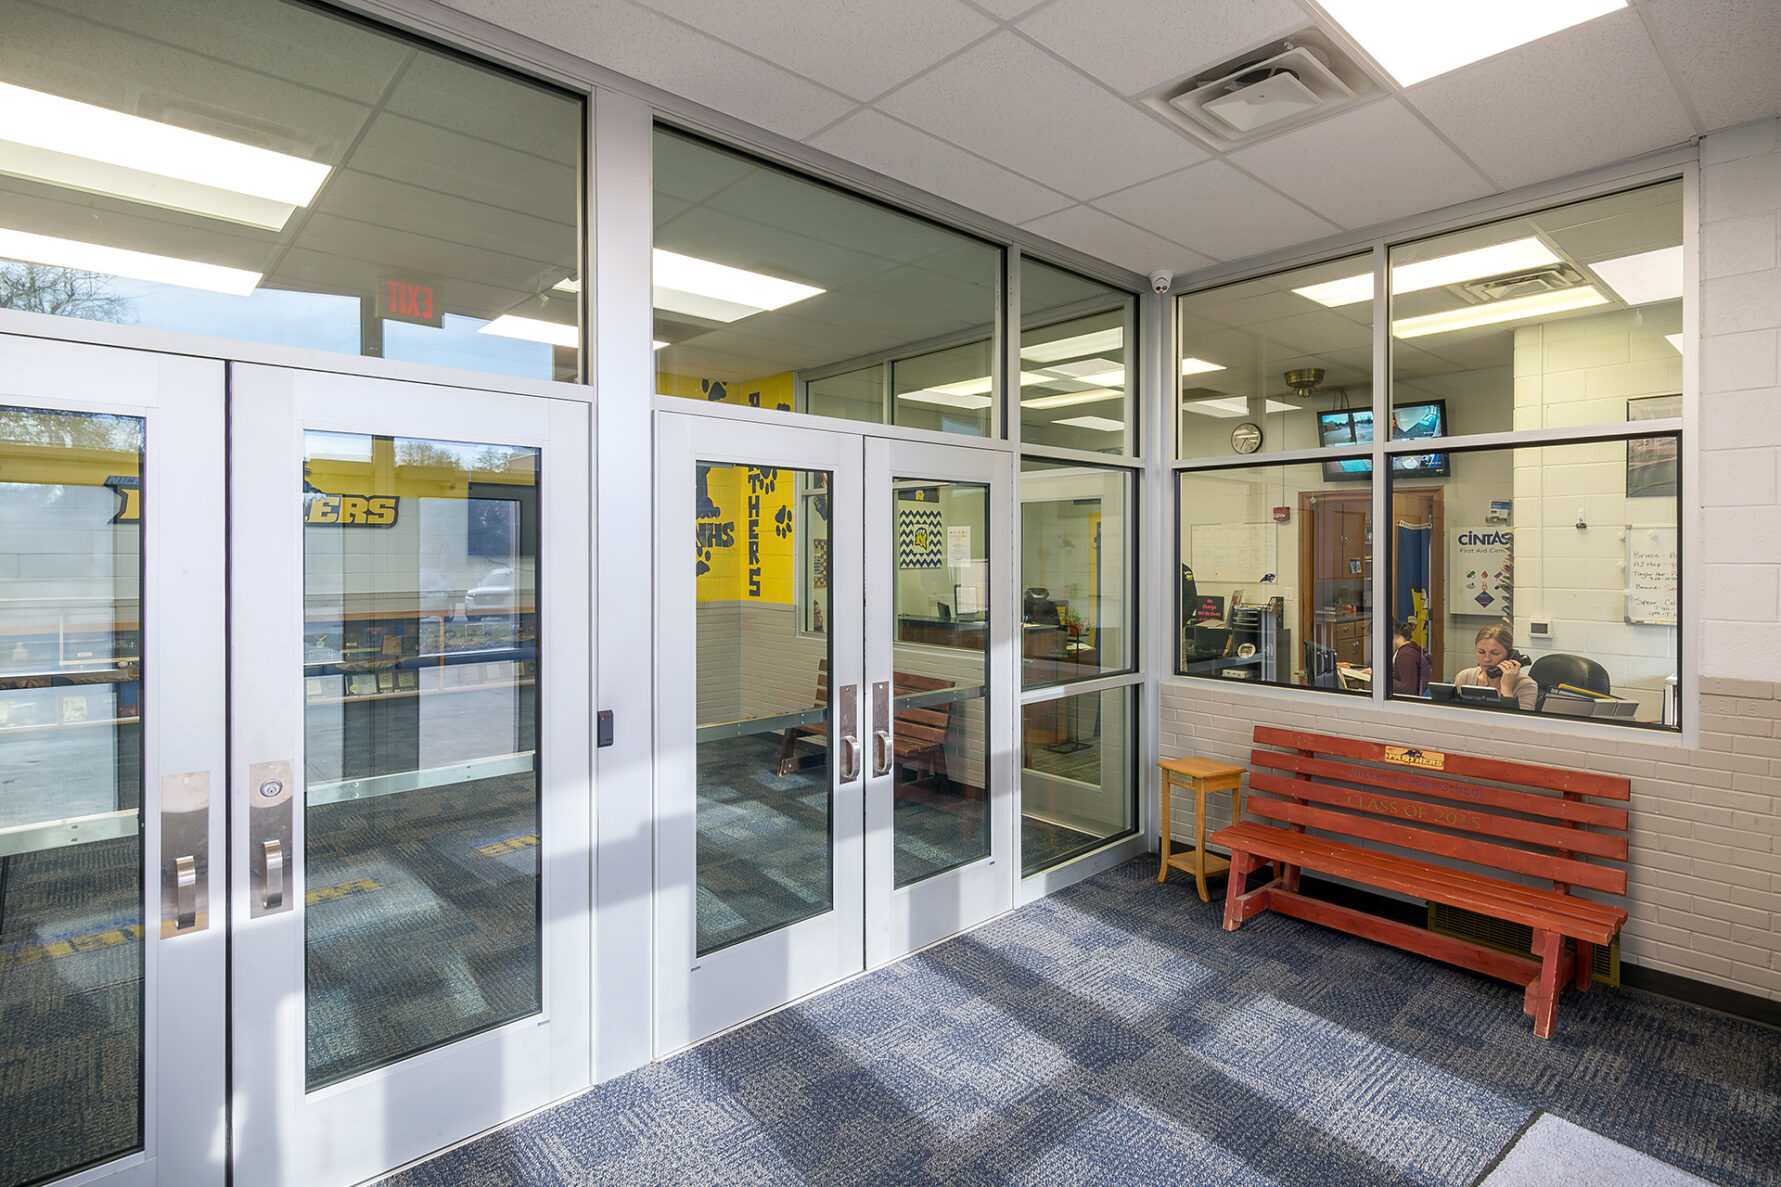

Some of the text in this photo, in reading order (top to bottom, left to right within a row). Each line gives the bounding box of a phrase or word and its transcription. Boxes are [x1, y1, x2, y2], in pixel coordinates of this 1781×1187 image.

[304, 494, 399, 526] ERS
[1352, 767, 1483, 798] Nickerson High School
[1347, 792, 1481, 830] CLASS OF 2015
